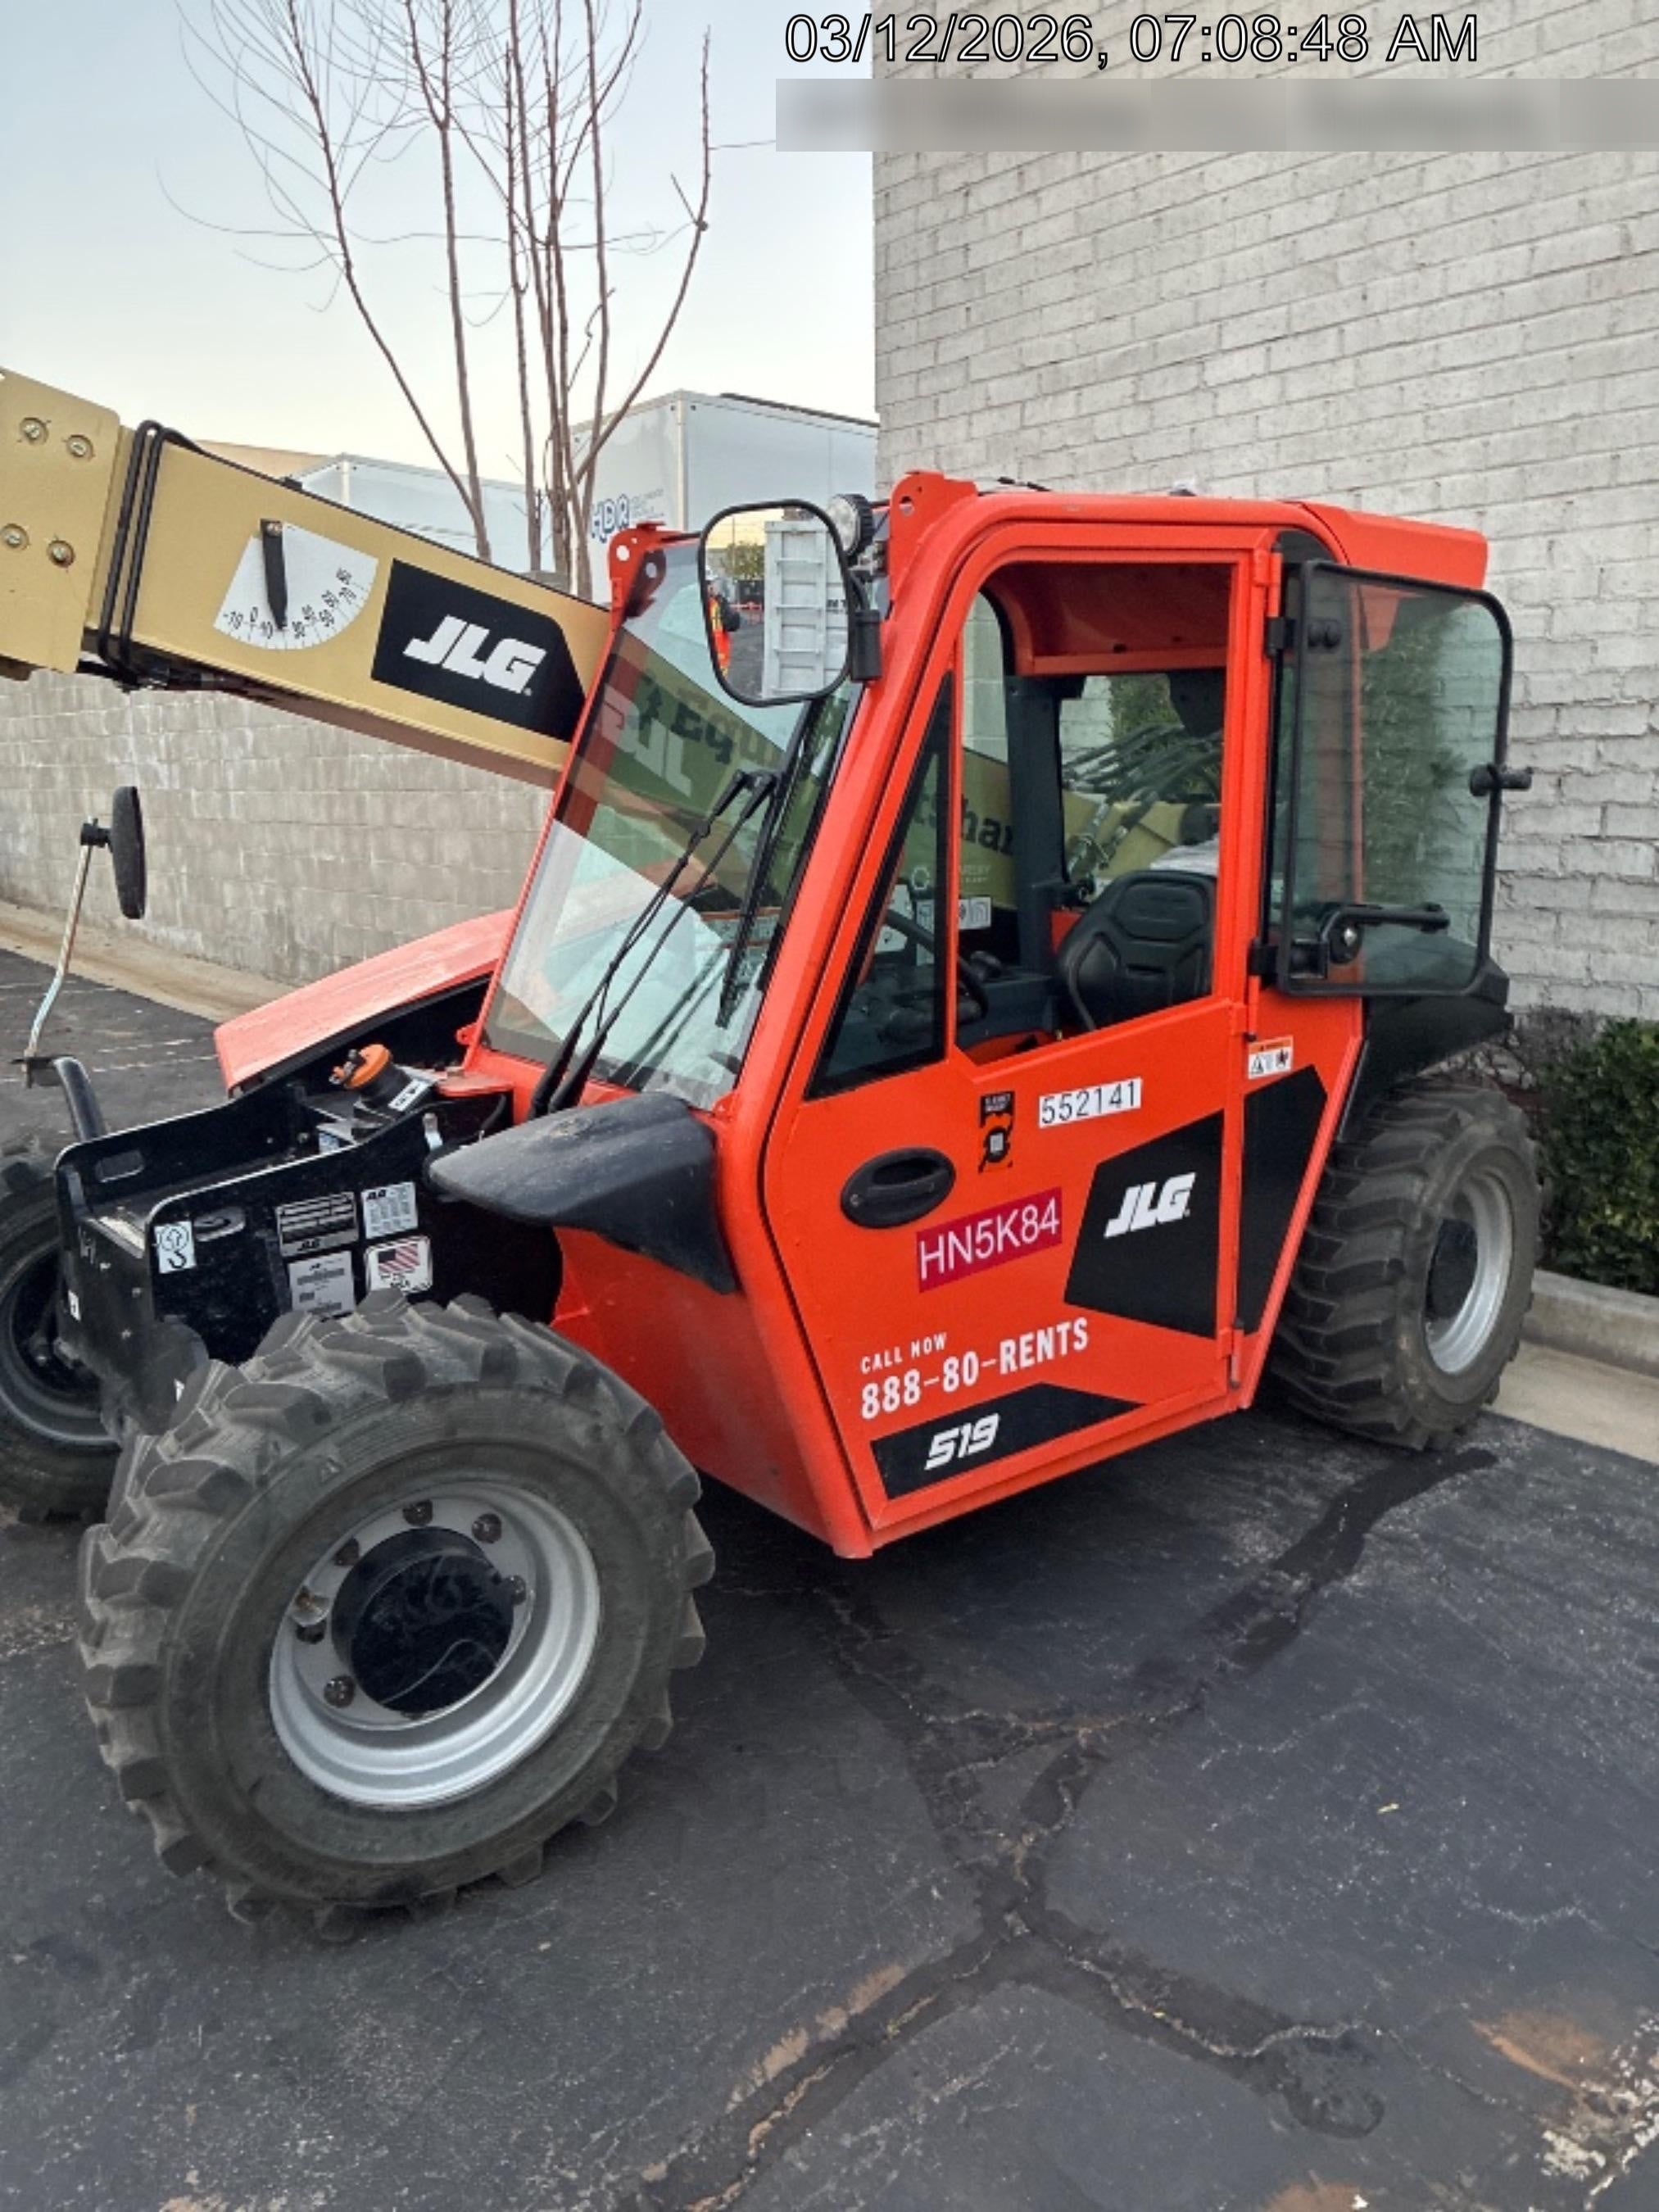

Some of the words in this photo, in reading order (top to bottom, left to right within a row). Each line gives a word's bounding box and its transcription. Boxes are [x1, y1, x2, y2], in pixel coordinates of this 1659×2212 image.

[403, 614, 546, 695] JLG
[1041, 1080, 1138, 1125] 552141
[919, 1197, 1059, 1280] HN5K84
[1104, 1172, 1196, 1239] JLG
[860, 1346, 903, 1374] CALL
[911, 1331, 947, 1358] NOW
[861, 1317, 1089, 1420] 888-80-RENTS
[923, 1412, 999, 1471] 519
